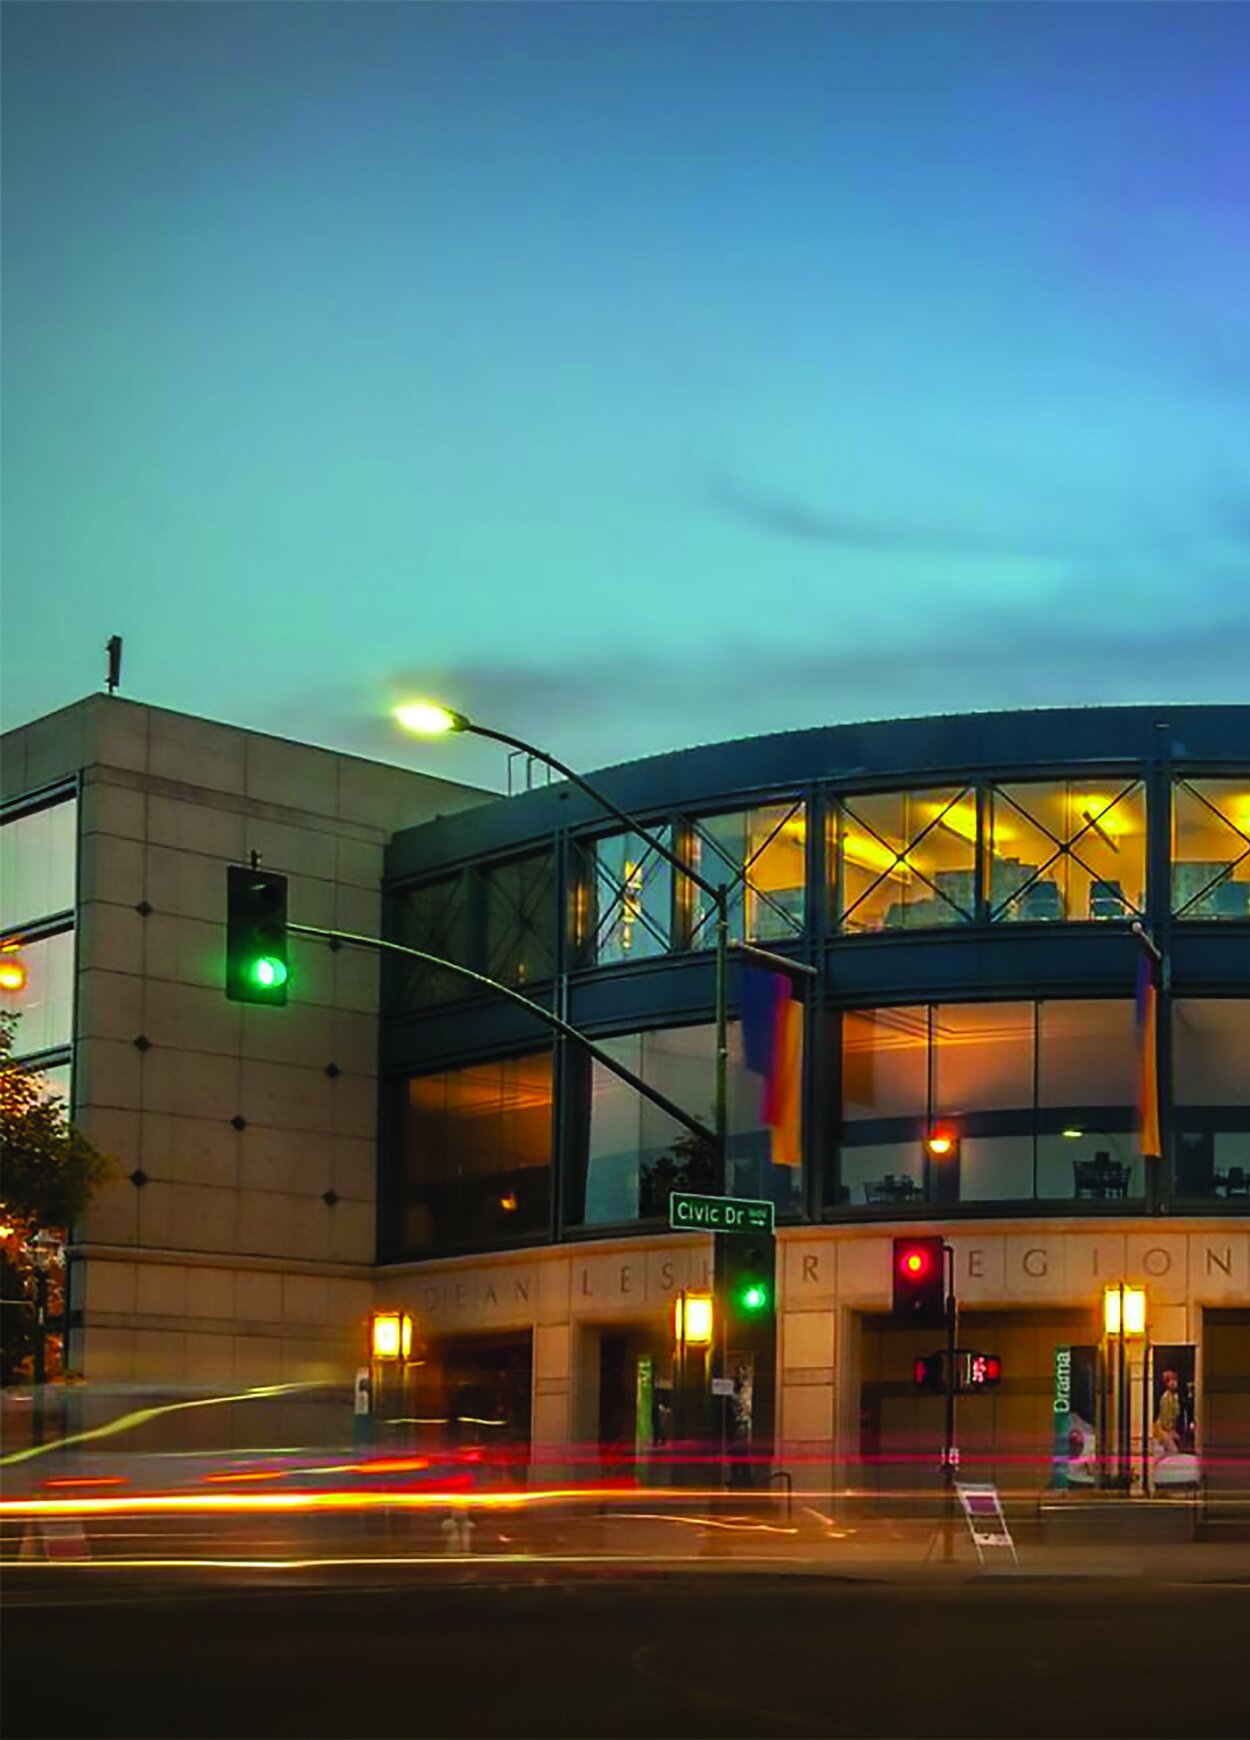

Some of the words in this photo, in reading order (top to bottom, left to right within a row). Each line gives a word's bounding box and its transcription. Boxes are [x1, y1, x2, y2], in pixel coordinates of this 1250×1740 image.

[677, 1201, 719, 1222] Civic
[725, 1206, 745, 1225] Dr
[425, 1279, 529, 1311] DEAN
[582, 1254, 819, 1296] LESR
[1054, 1351, 1071, 1413] Drama
